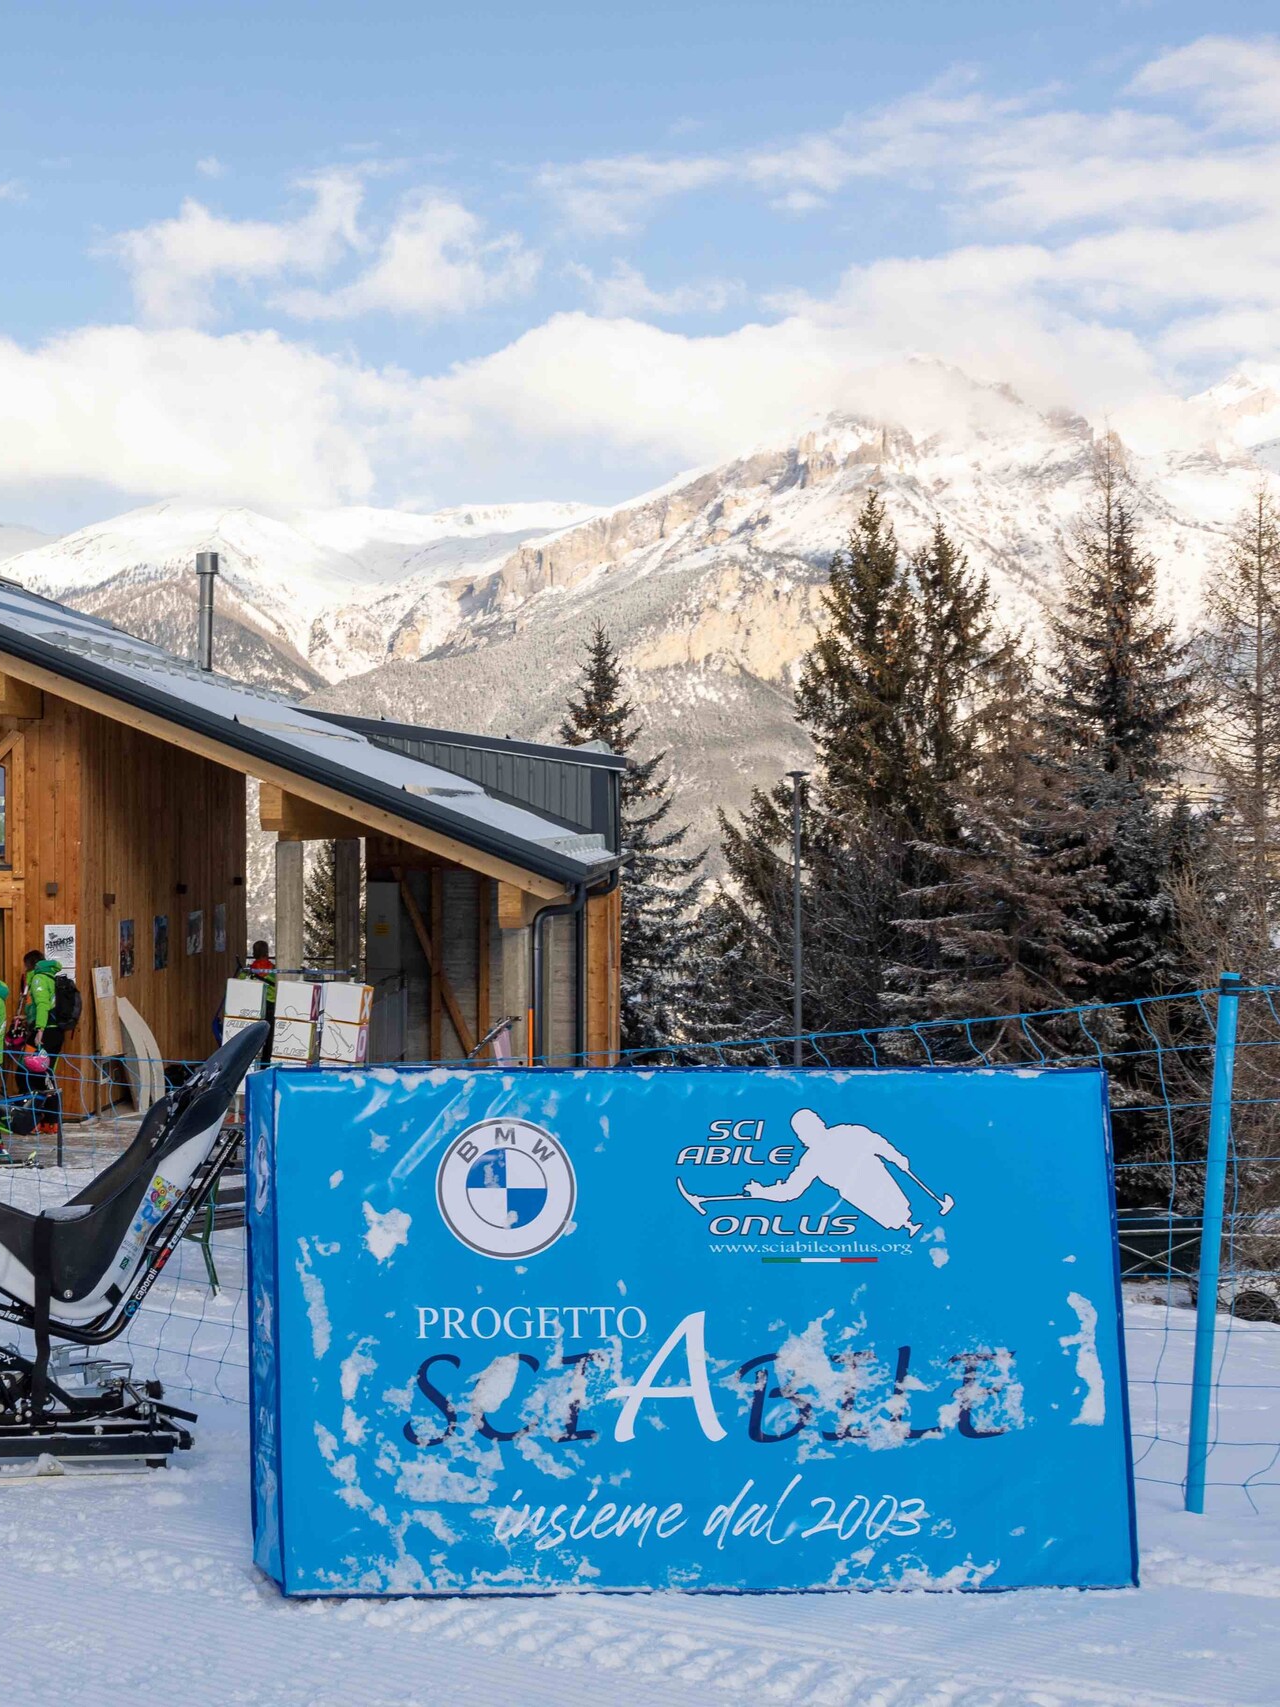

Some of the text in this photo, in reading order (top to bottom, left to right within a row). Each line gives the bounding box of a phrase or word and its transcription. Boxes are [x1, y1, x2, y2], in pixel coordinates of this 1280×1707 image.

[456, 1127, 556, 1164] BMW
[707, 1120, 766, 1141] SCI
[675, 1145, 795, 1166] ABILE
[167, 1206, 197, 1250] tessier
[708, 1241, 913, 1256] www.sciabileonlus.org
[135, 1267, 158, 1301] caporali
[417, 1306, 648, 1341] PROGETTO
[494, 1474, 927, 1551] insieme dal 2003
